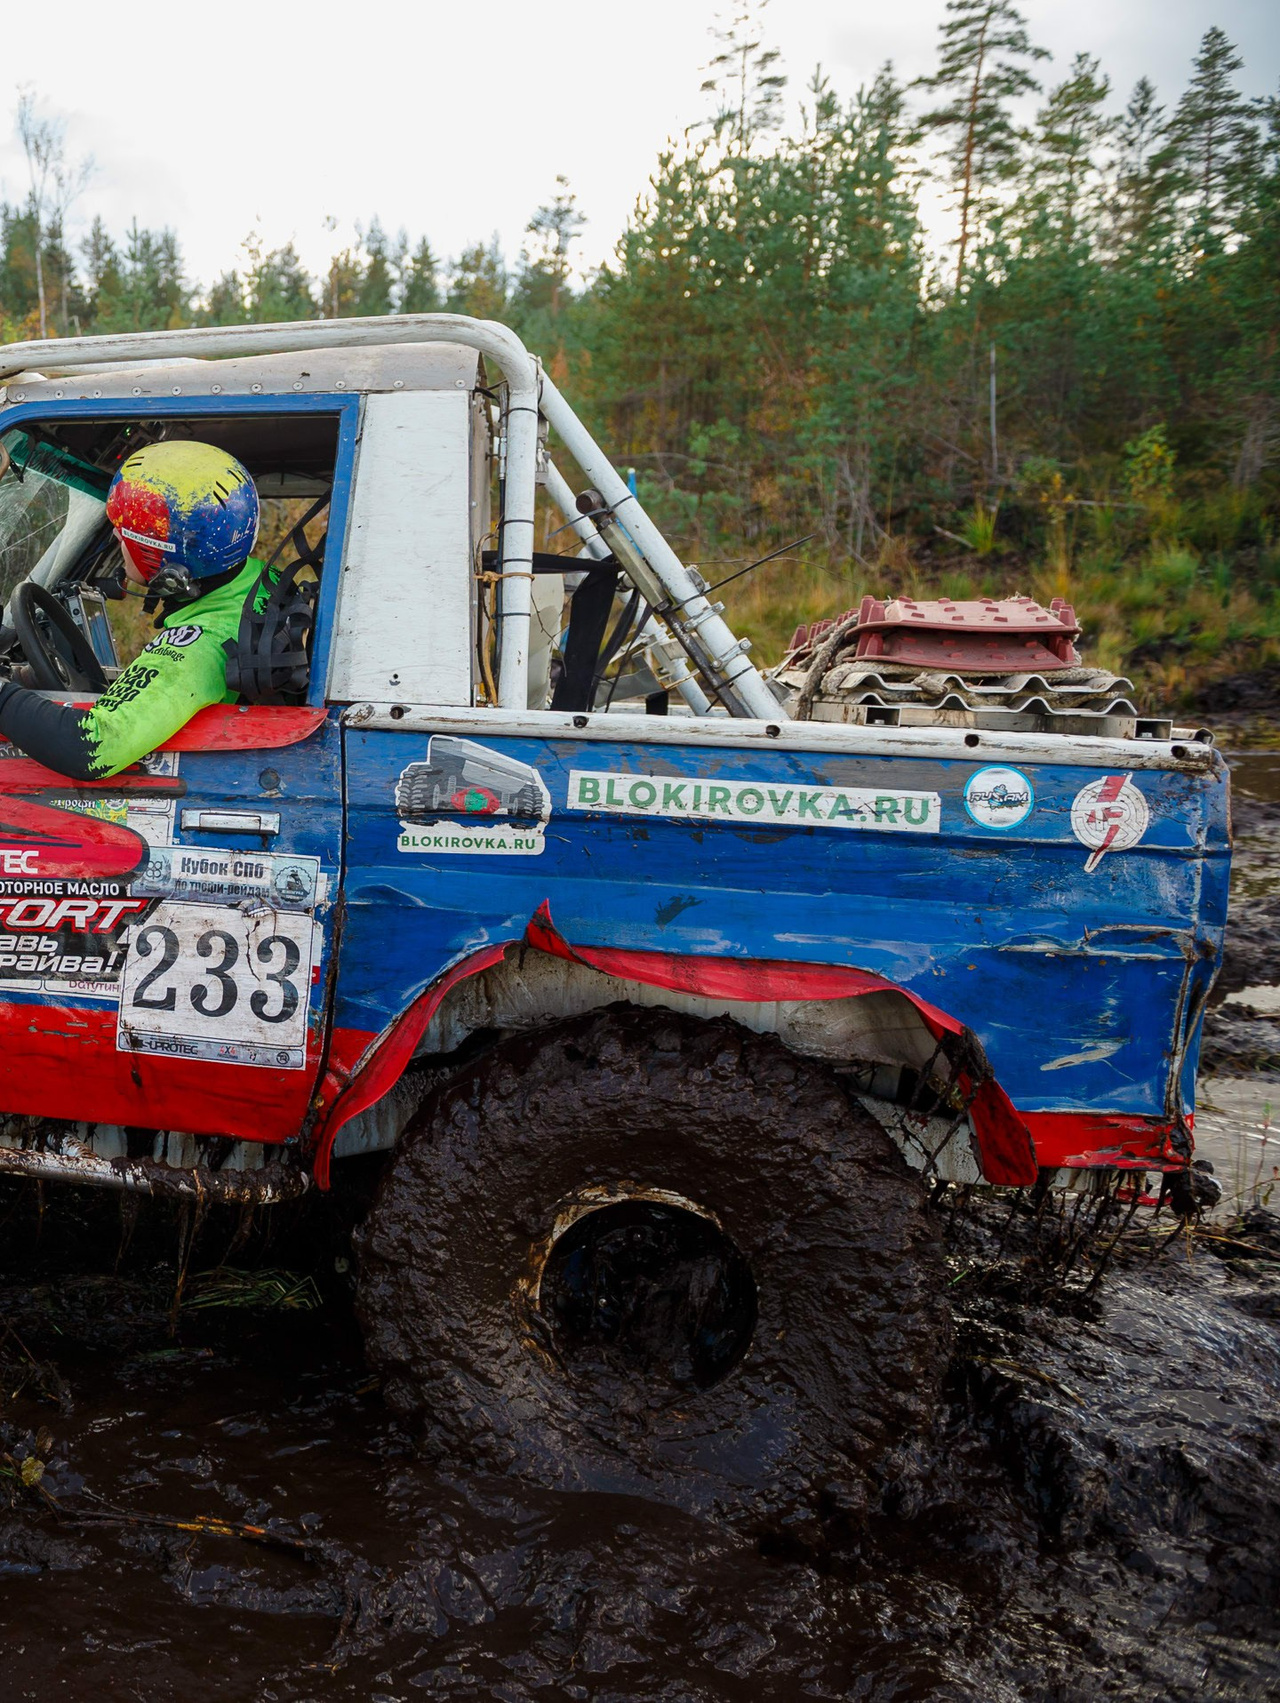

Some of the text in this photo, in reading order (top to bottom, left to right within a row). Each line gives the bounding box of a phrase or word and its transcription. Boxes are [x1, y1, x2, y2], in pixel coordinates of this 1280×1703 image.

[123, 530, 174, 550] BLOKIROVKA.RU
[578, 776, 929, 826] BLOKIROVKA.RU
[401, 835, 536, 850] BLOKIROVKA.RU
[181, 856, 264, 879] Кубок СПб
[67, 882, 119, 896] МАСЛО
[132, 925, 300, 1023] 233
[141, 1038, 198, 1055] SUPROTEC
